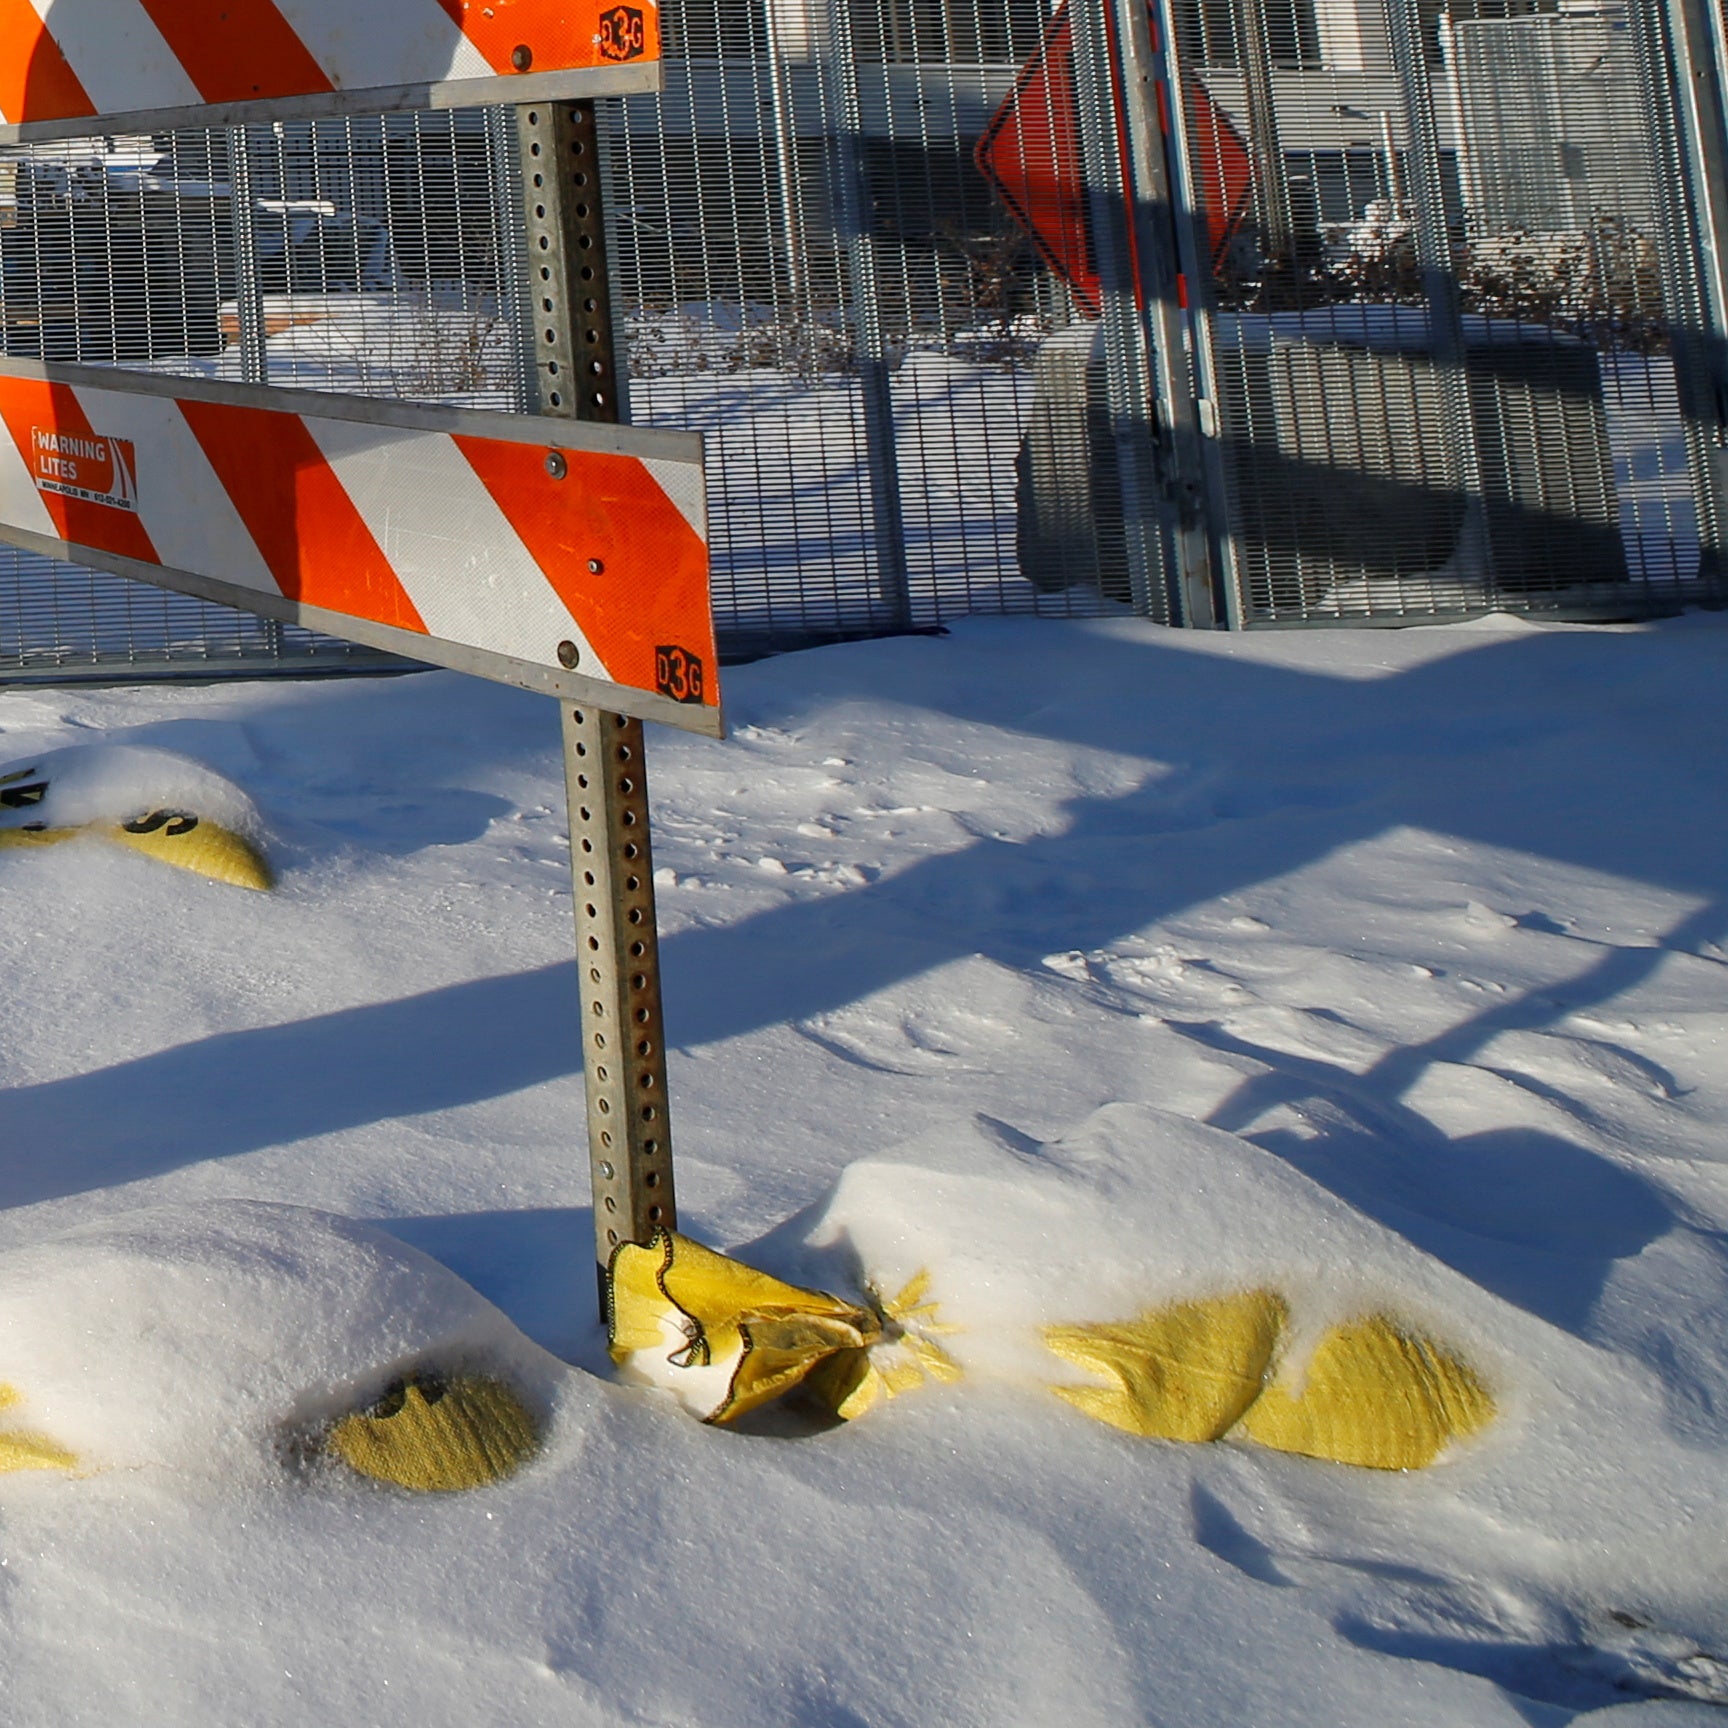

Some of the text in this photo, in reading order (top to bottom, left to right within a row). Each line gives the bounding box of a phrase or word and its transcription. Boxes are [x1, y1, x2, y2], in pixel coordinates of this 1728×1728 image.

[38, 430, 106, 462] WARNING
[40, 455, 78, 480] LITES
[657, 648, 701, 700] D3G
